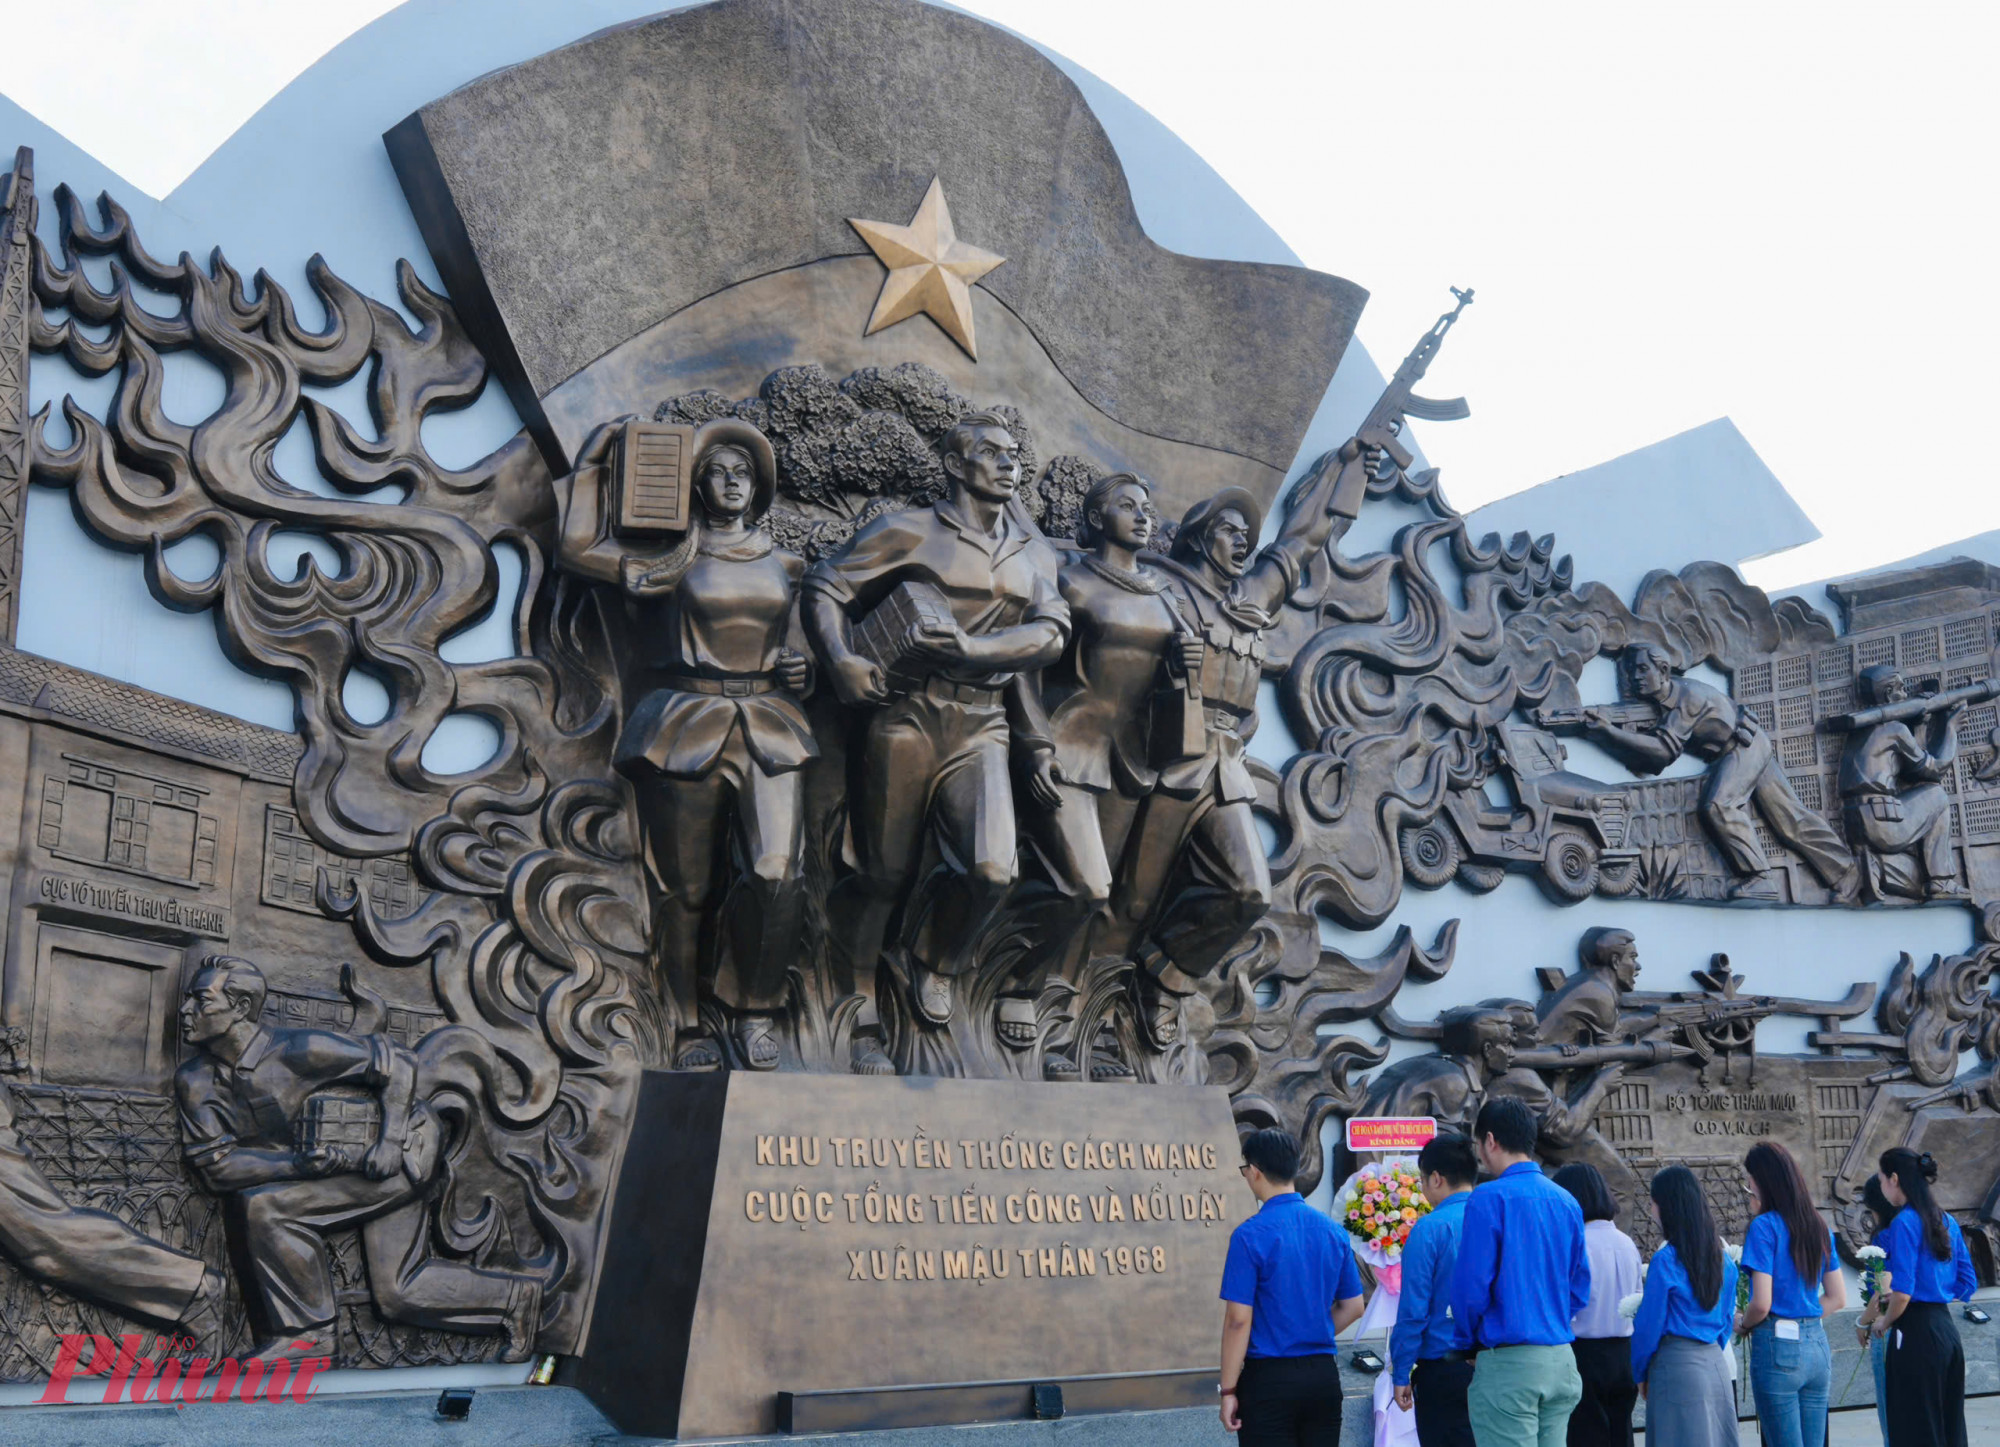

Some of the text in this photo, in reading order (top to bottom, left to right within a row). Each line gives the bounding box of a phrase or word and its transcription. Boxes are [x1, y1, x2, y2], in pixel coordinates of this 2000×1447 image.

[41, 876, 68, 903] CỤC
[185, 906, 225, 934] THANH
[1666, 1088, 1687, 1115] BỘ
[1690, 1087, 1730, 1111] TỔNG
[1733, 1093, 1767, 1111] THAM
[755, 1125, 1218, 1177] KHU TRUYỀN THỐNG CÁCH MẠNG
[1370, 1138, 1392, 1146] KÍNH
[745, 1180, 1227, 1231] CUỘC TỔNG TIẾN CÔNG VÀ NỔI DẬY
[846, 1241, 1168, 1286] XUÂN MẬU THÂN 1968
